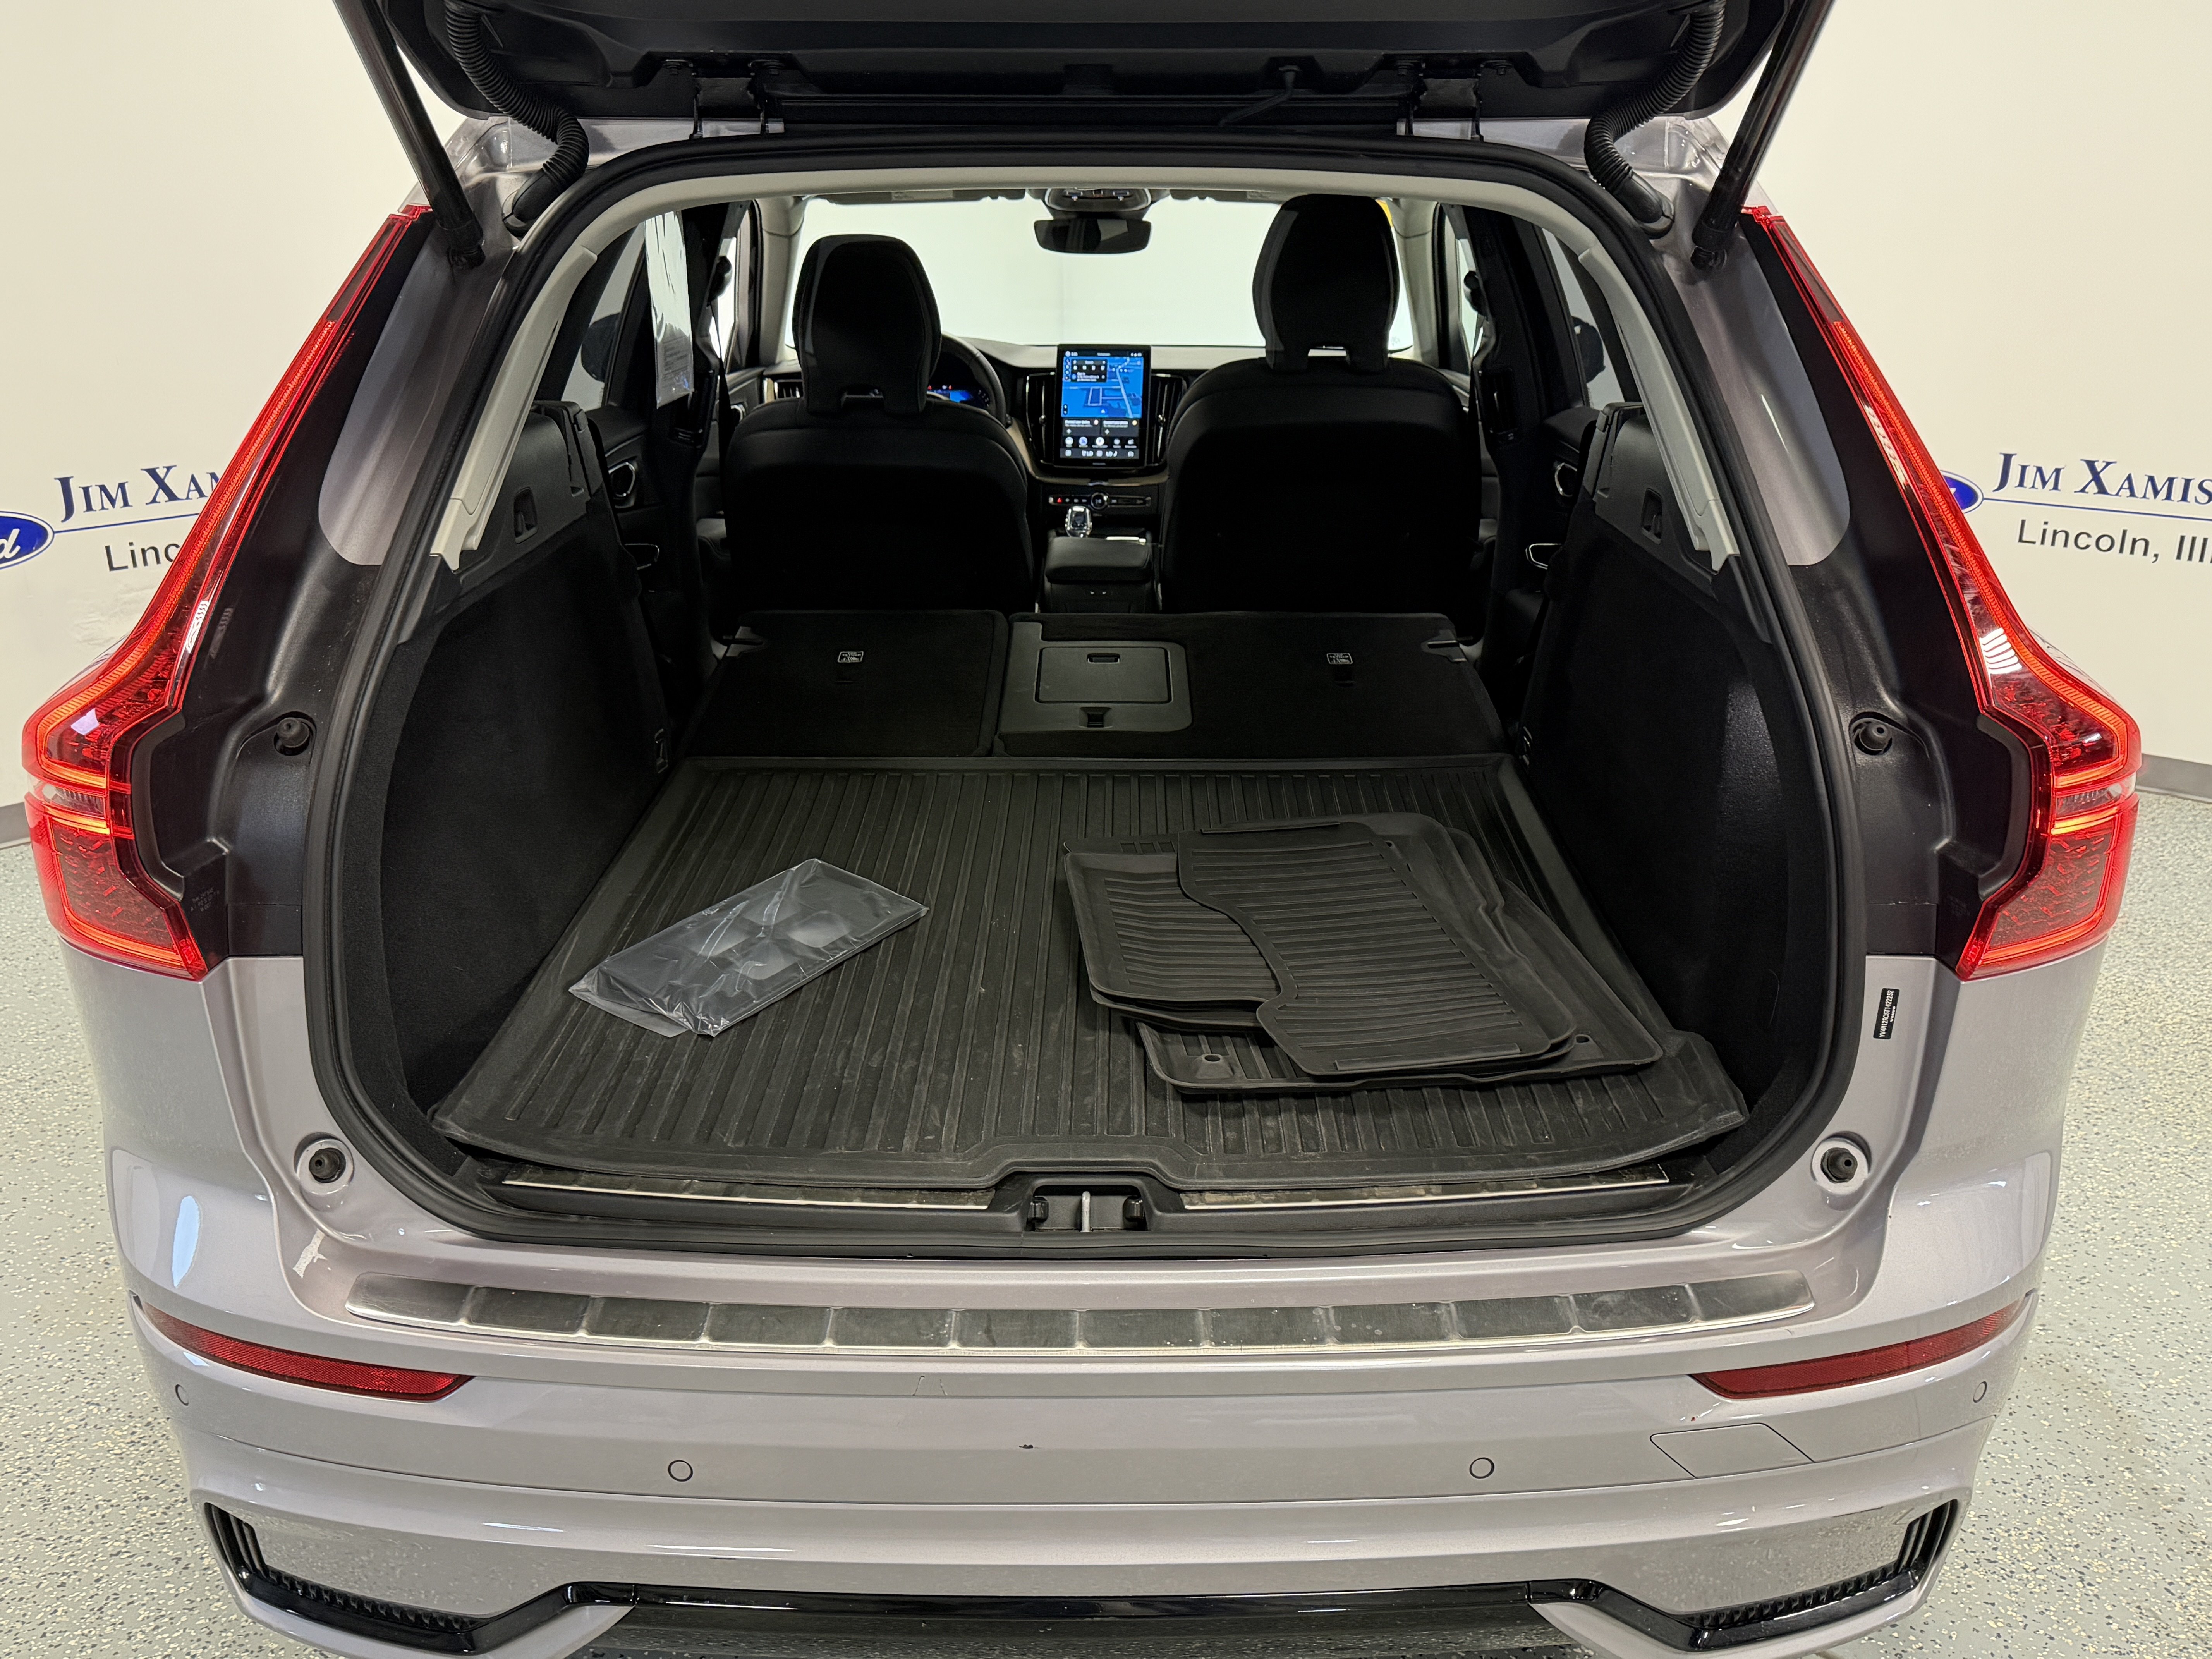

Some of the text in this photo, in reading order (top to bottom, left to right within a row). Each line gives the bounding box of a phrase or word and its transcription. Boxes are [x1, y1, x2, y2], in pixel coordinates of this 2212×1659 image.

[1992, 452, 2065, 493] JIM
[54, 476, 133, 523] JIM
[2018, 519, 2212, 563] Lincoln, Ill
